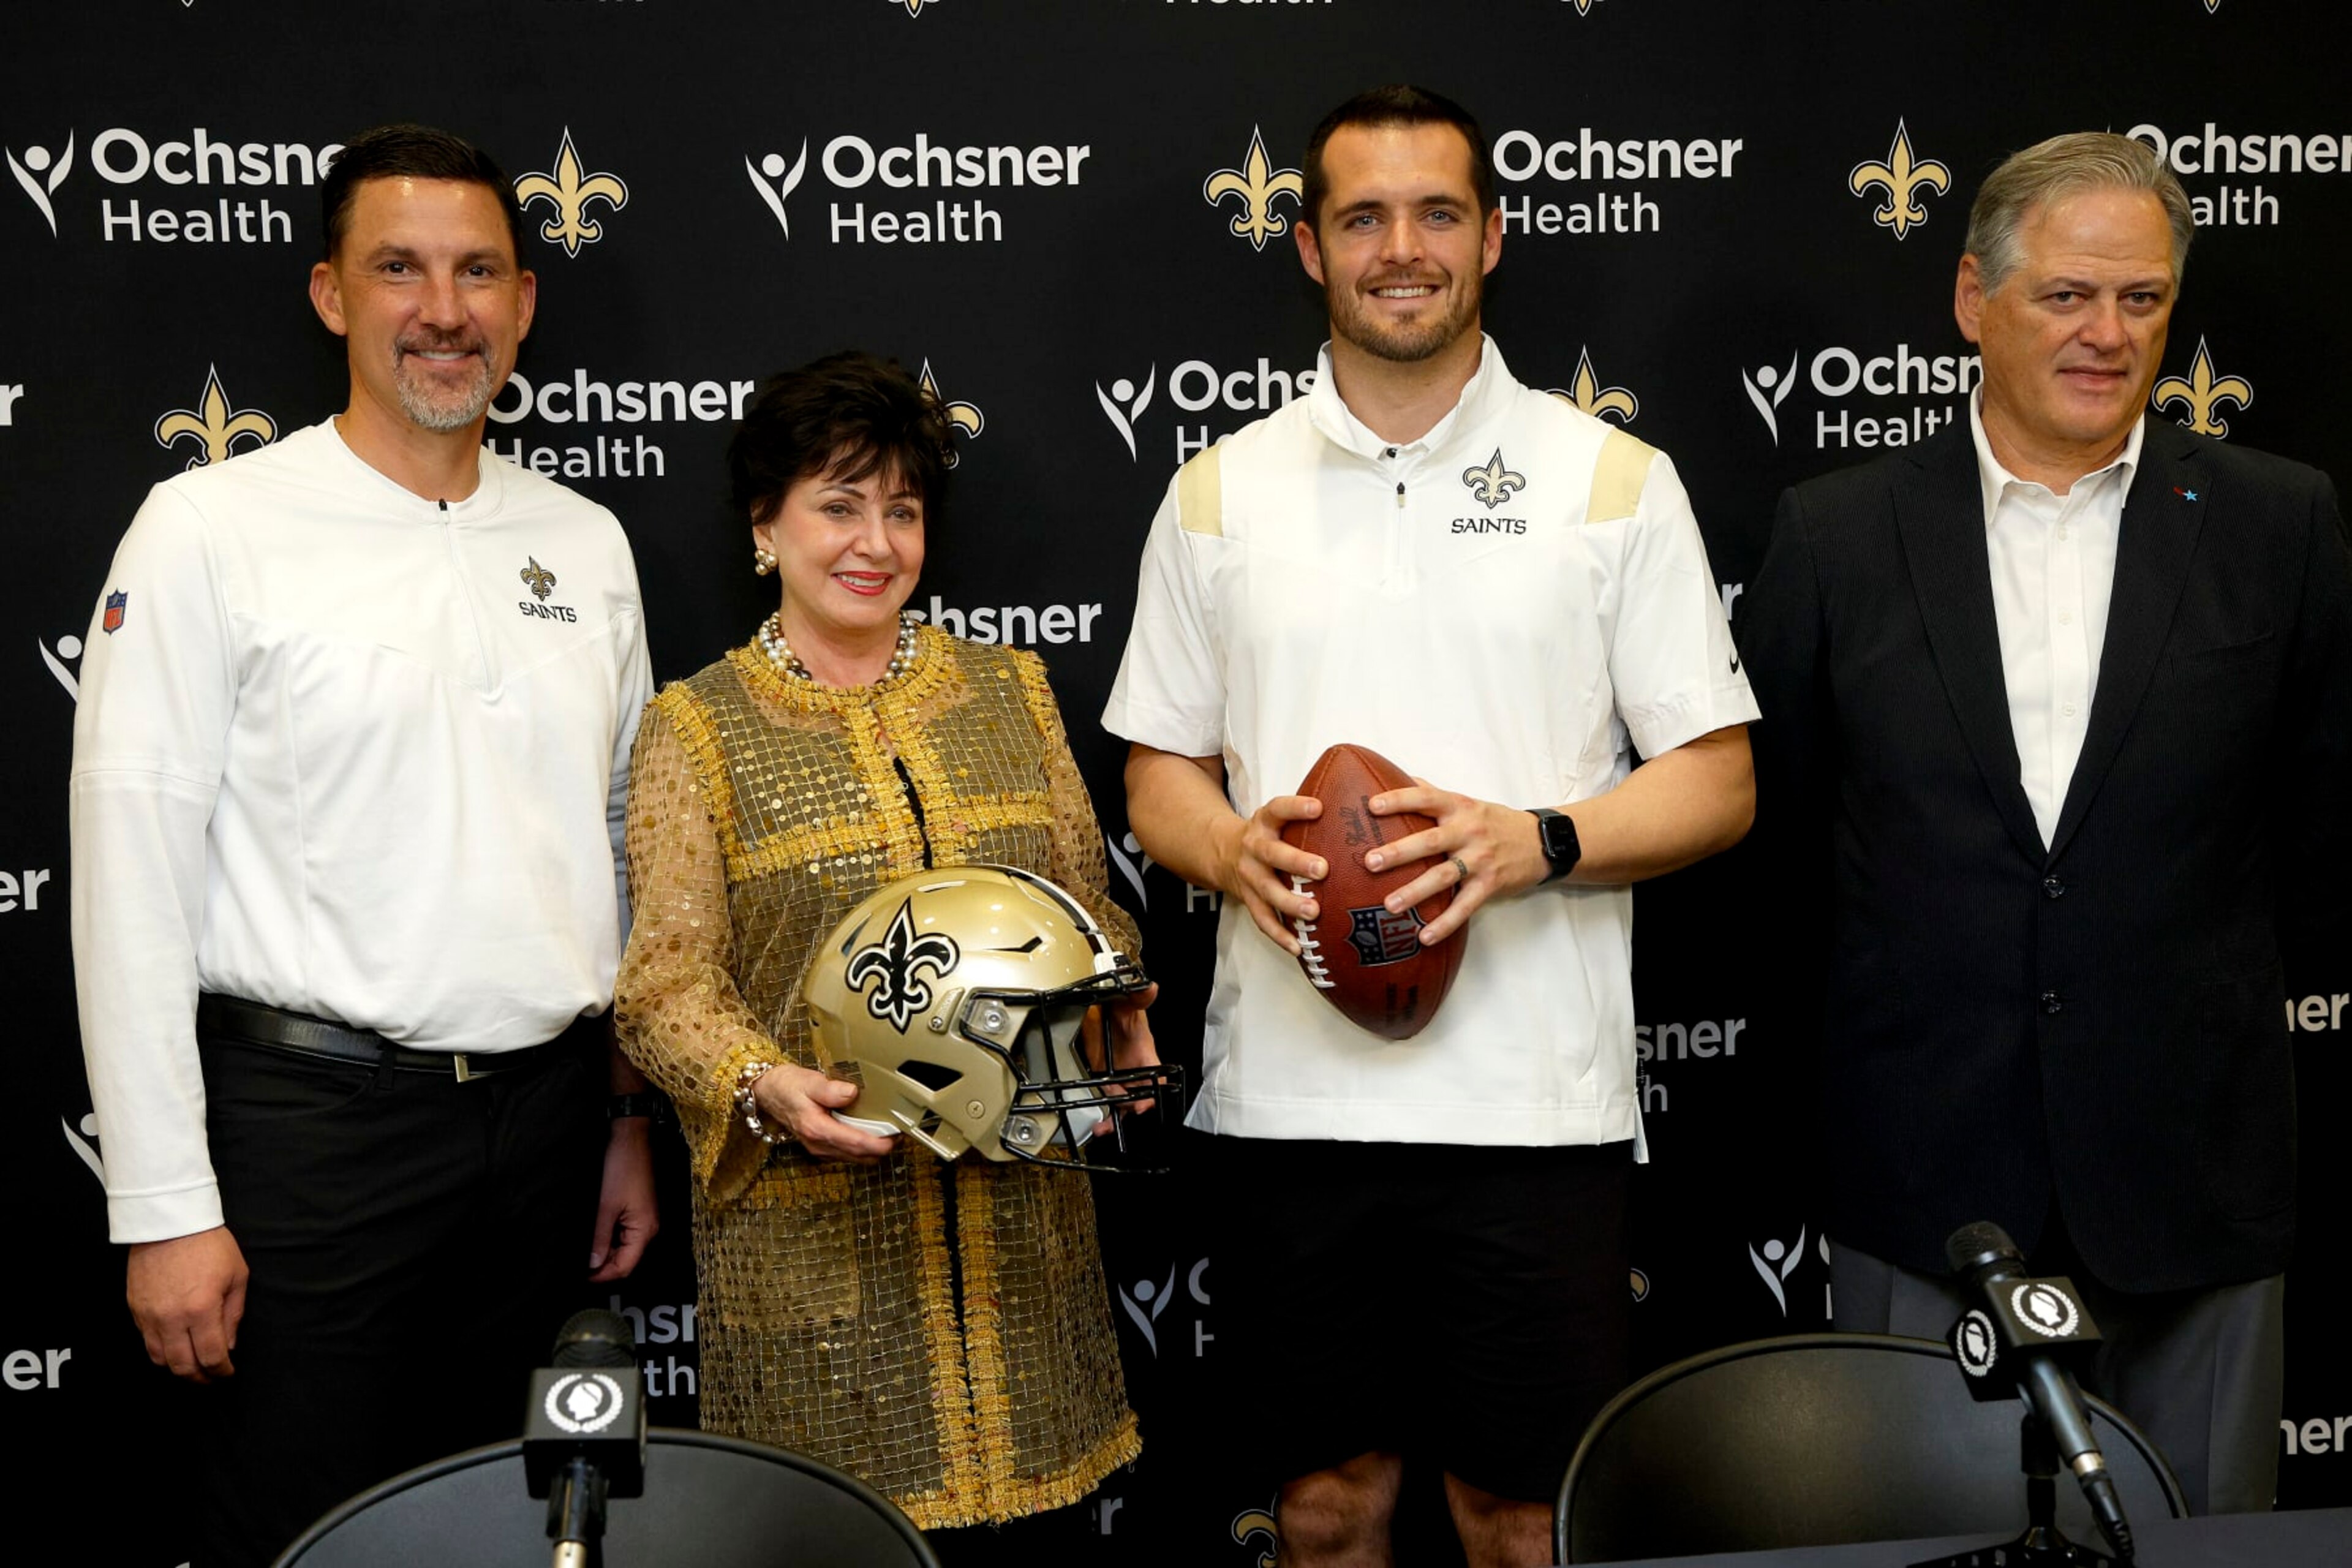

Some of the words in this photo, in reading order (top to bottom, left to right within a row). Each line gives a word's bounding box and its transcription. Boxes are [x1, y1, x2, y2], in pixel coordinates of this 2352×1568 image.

[822, 133, 1090, 188] Ochsner
[1493, 127, 1743, 181] Ochsner
[102, 198, 293, 243] Health
[831, 200, 1002, 243] Health
[1499, 192, 1660, 235] Health
[2192, 186, 2279, 226] alth
[1811, 344, 1983, 397] Ochsn
[1817, 405, 1953, 449] Healt
[1451, 518, 1526, 535] SAINTS
[519, 601, 577, 623] SAINTS
[907, 595, 1102, 645] hsner
[1379, 910, 1417, 957] NFL
[1635, 1017, 1746, 1061] sner
